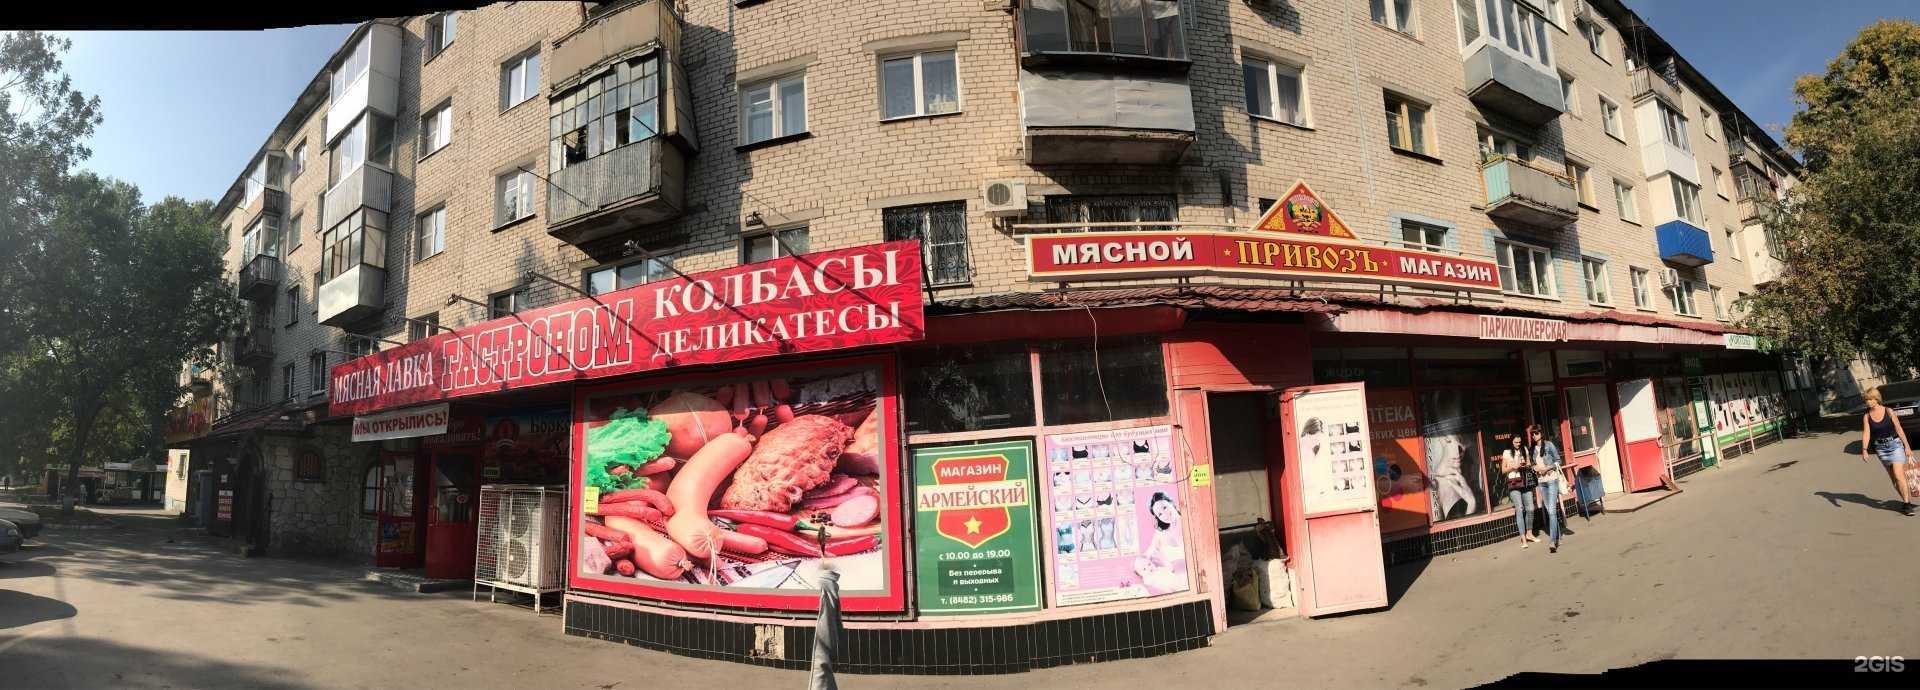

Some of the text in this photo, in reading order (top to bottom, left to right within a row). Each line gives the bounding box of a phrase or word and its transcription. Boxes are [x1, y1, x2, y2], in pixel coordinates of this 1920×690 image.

[1052, 236, 1492, 283] МЯСНОЙ ПРИВОЗЪ МАГАЗИН
[653, 250, 902, 320] КОЛБАСЫ
[652, 301, 903, 362] ДЕЛИКАТЕСЫ
[1481, 316, 1567, 340] ПАРИКМАХЕРСКАЯ
[333, 297, 634, 405] МЯСНАЯ ЛАВКА ГАСТРОНОМ
[354, 421, 371, 435] МЫ
[371, 411, 448, 433] ОТКРЫЛИСЬ!
[1368, 405, 1416, 423] ПТЕКА
[940, 463, 1002, 477] МАГАЗИН
[919, 481, 1026, 508] АРМЕЙСКИЙ
[945, 551, 970, 560] 10.00
[986, 549, 1011, 558] 19.00
[960, 577, 999, 585] выходных
[964, 568, 1002, 576] перерыва
[949, 595, 977, 604] (8482)
